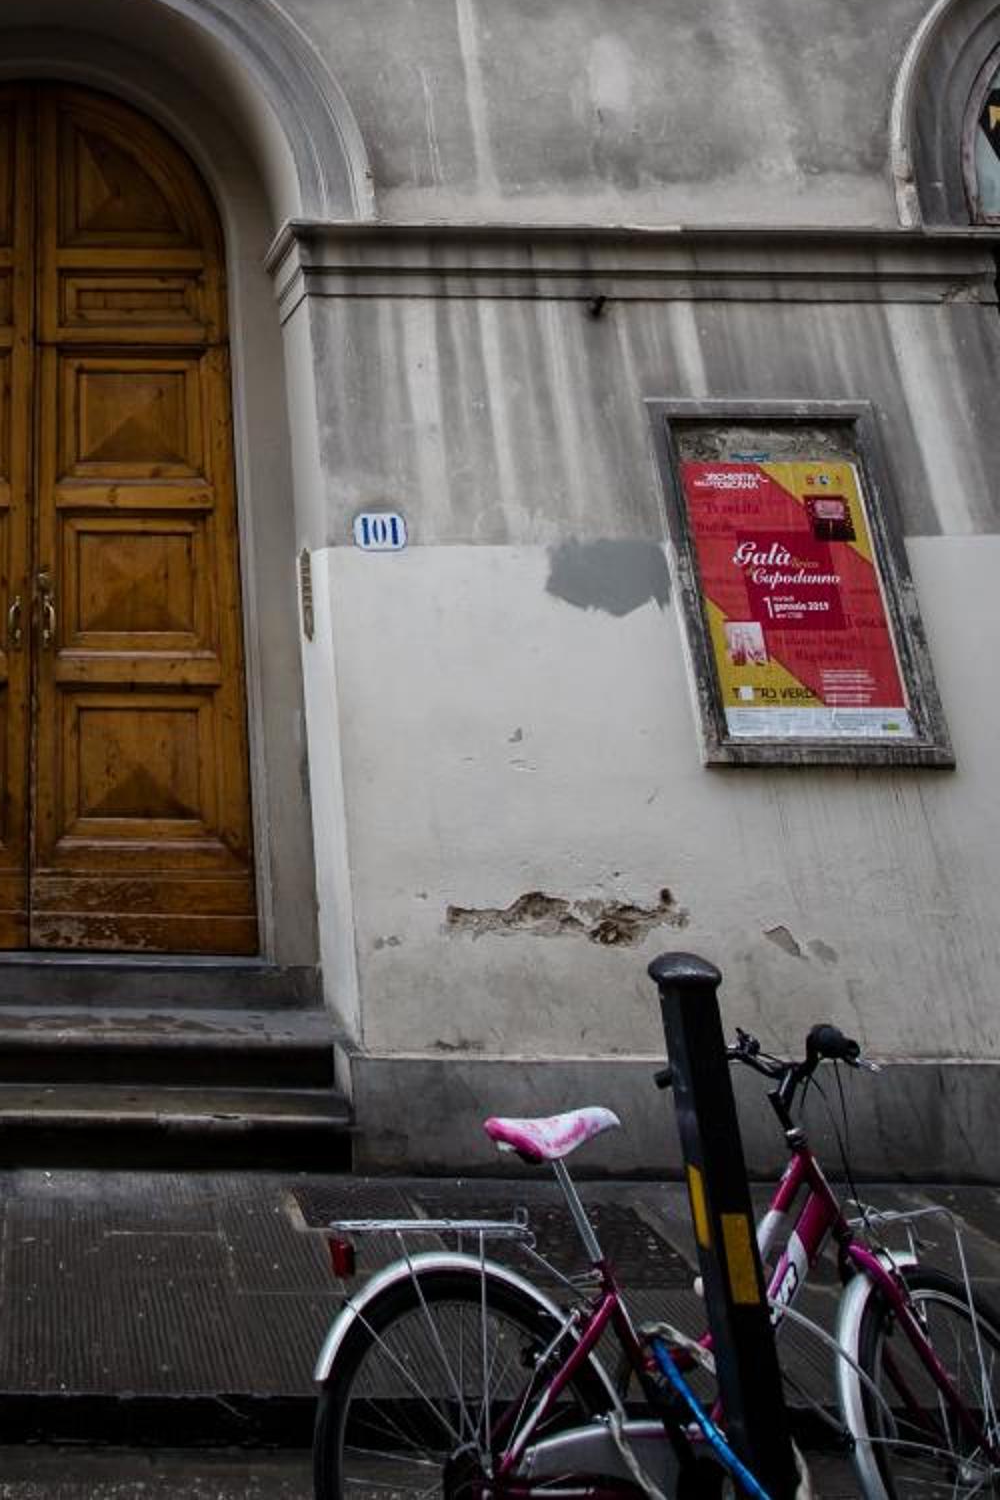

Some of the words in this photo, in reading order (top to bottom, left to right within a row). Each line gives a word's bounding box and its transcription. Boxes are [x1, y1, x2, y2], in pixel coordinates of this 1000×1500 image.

[361, 517, 399, 545] 101
[732, 541, 791, 566] Galà
[752, 568, 841, 590] Capodanno
